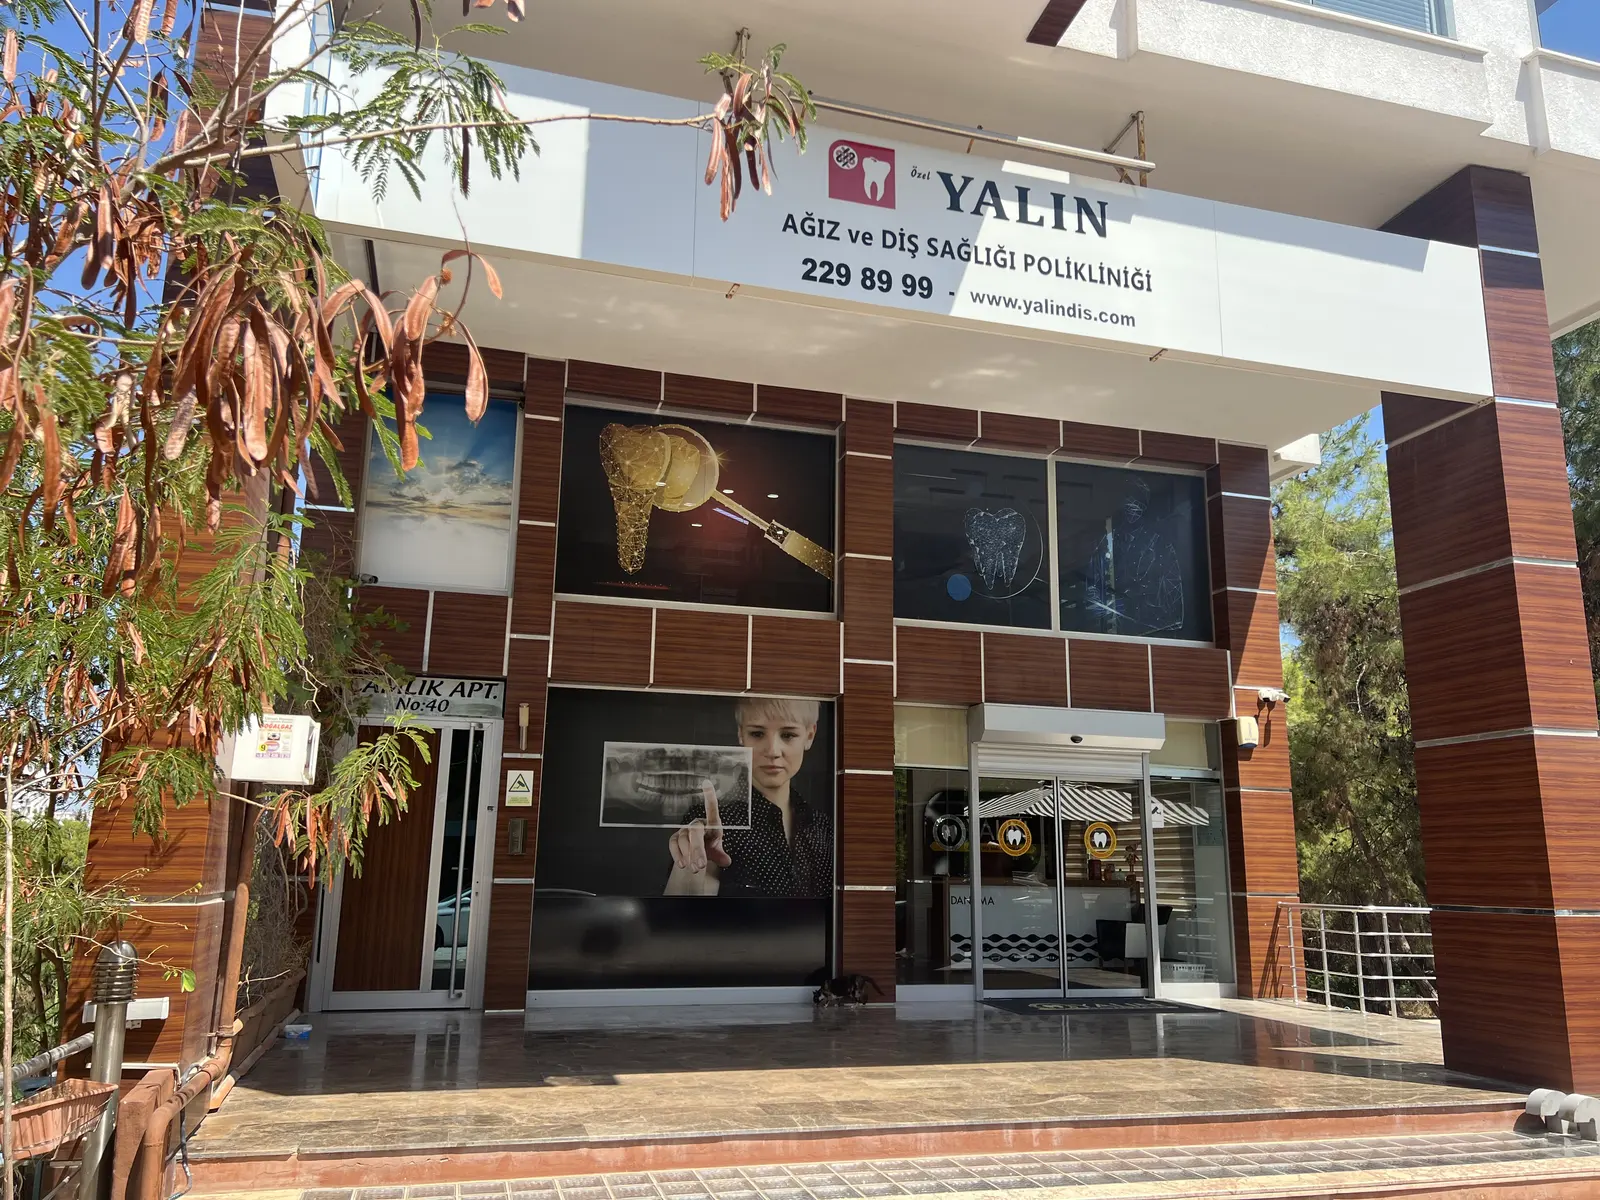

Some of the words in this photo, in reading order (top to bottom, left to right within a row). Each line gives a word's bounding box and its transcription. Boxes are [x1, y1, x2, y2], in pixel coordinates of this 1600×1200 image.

[910, 166, 931, 180] Özel
[936, 171, 1109, 238] YALIN
[782, 211, 841, 241] AĞIZ
[848, 228, 873, 246] ve
[881, 227, 919, 259] DİŞ
[927, 237, 1016, 270] SAĞLIĞI
[1024, 253, 1152, 292] POLİKLİNİĞİ
[801, 257, 851, 287] 229
[860, 267, 893, 293] 89
[901, 273, 933, 299] 99
[970, 291, 1136, 327] www.yalindis.com
[349, 679, 444, 697] AMLIK
[449, 681, 499, 700] APT.
[395, 697, 450, 713] No:40
[950, 895, 995, 906] DANMA
